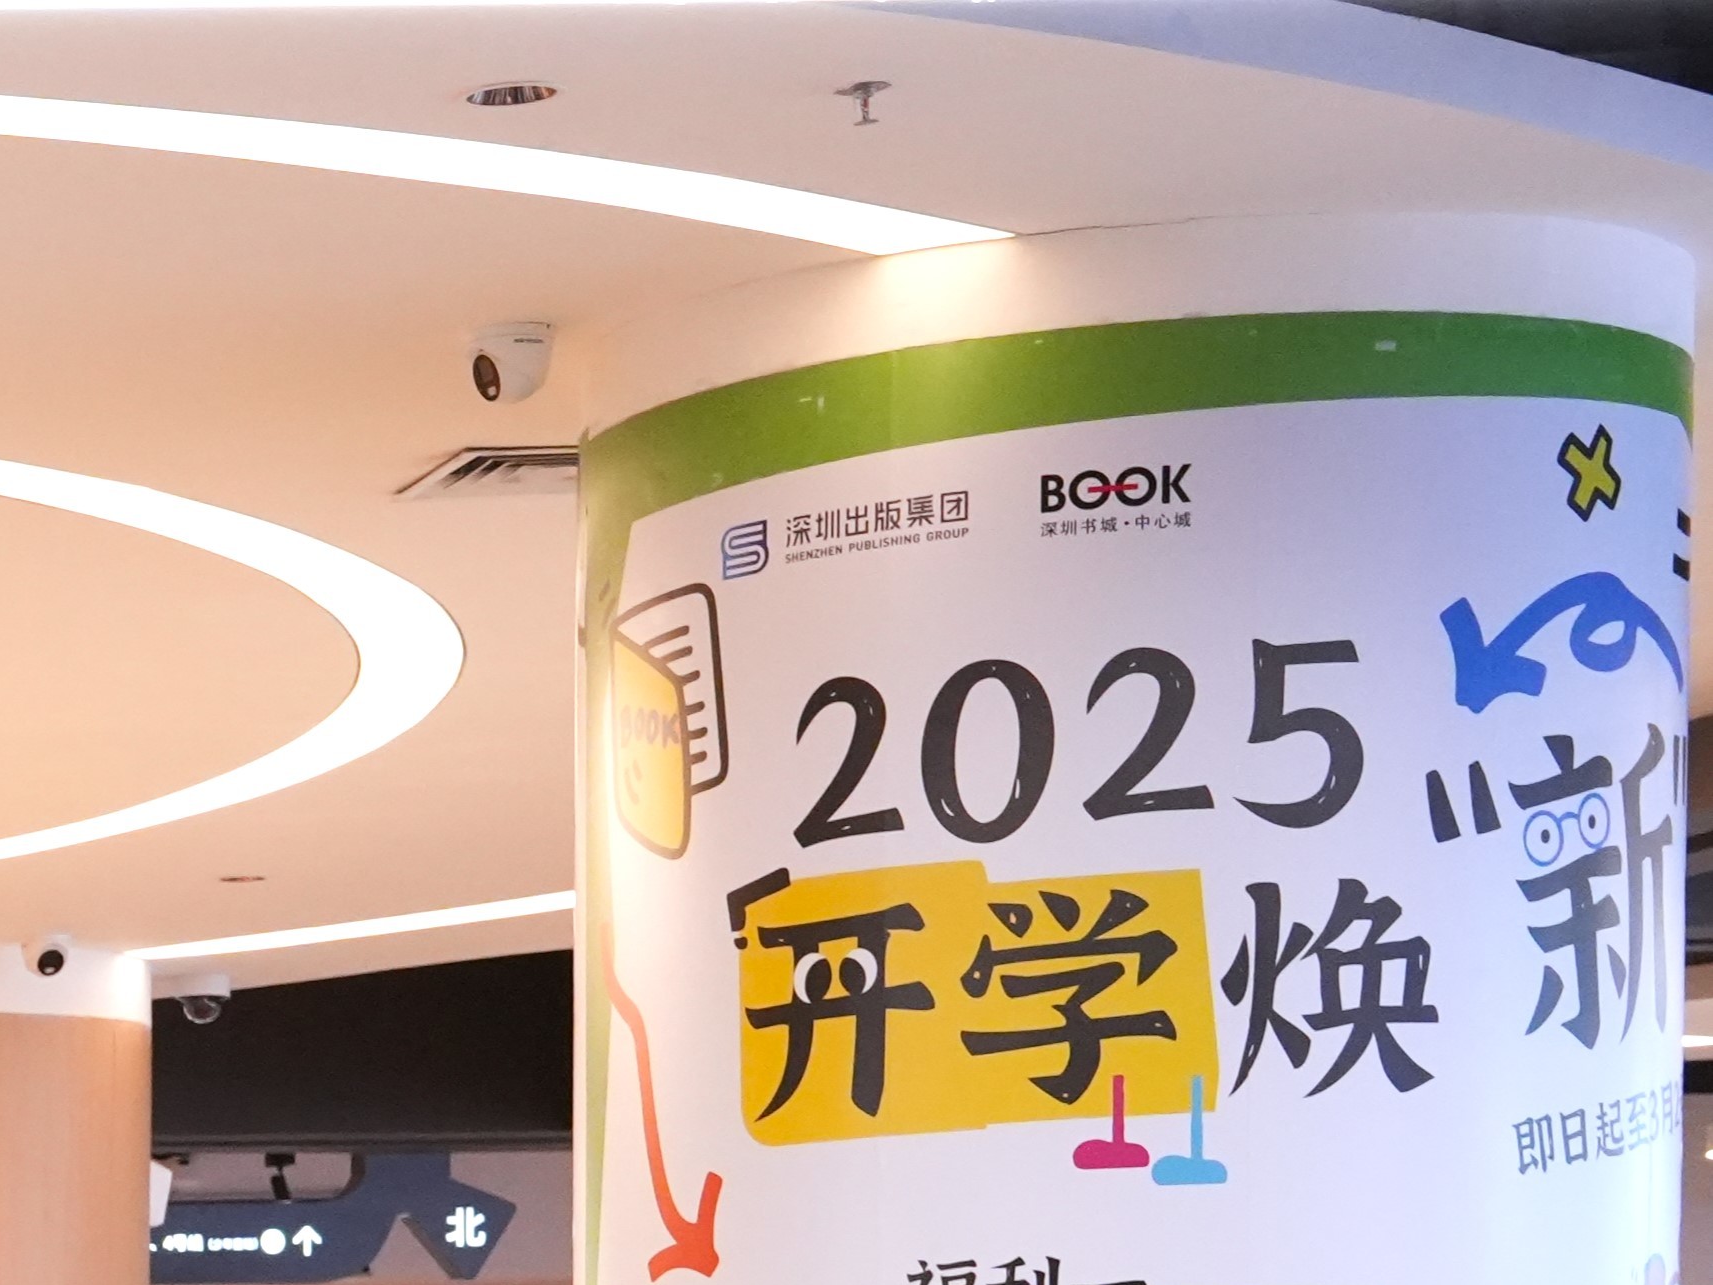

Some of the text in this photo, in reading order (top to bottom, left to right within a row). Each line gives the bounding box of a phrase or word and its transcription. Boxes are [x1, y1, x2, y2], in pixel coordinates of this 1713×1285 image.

[1041, 463, 1193, 513] BOOK
[785, 490, 969, 548] 深圳出版集团
[1041, 510, 1193, 538] 深圳书城·中心城
[785, 526, 970, 564] SHENZHEN PUBLISHING GROUP
[793, 638, 1365, 850] 2025
[444, 1206, 487, 1247] 北
